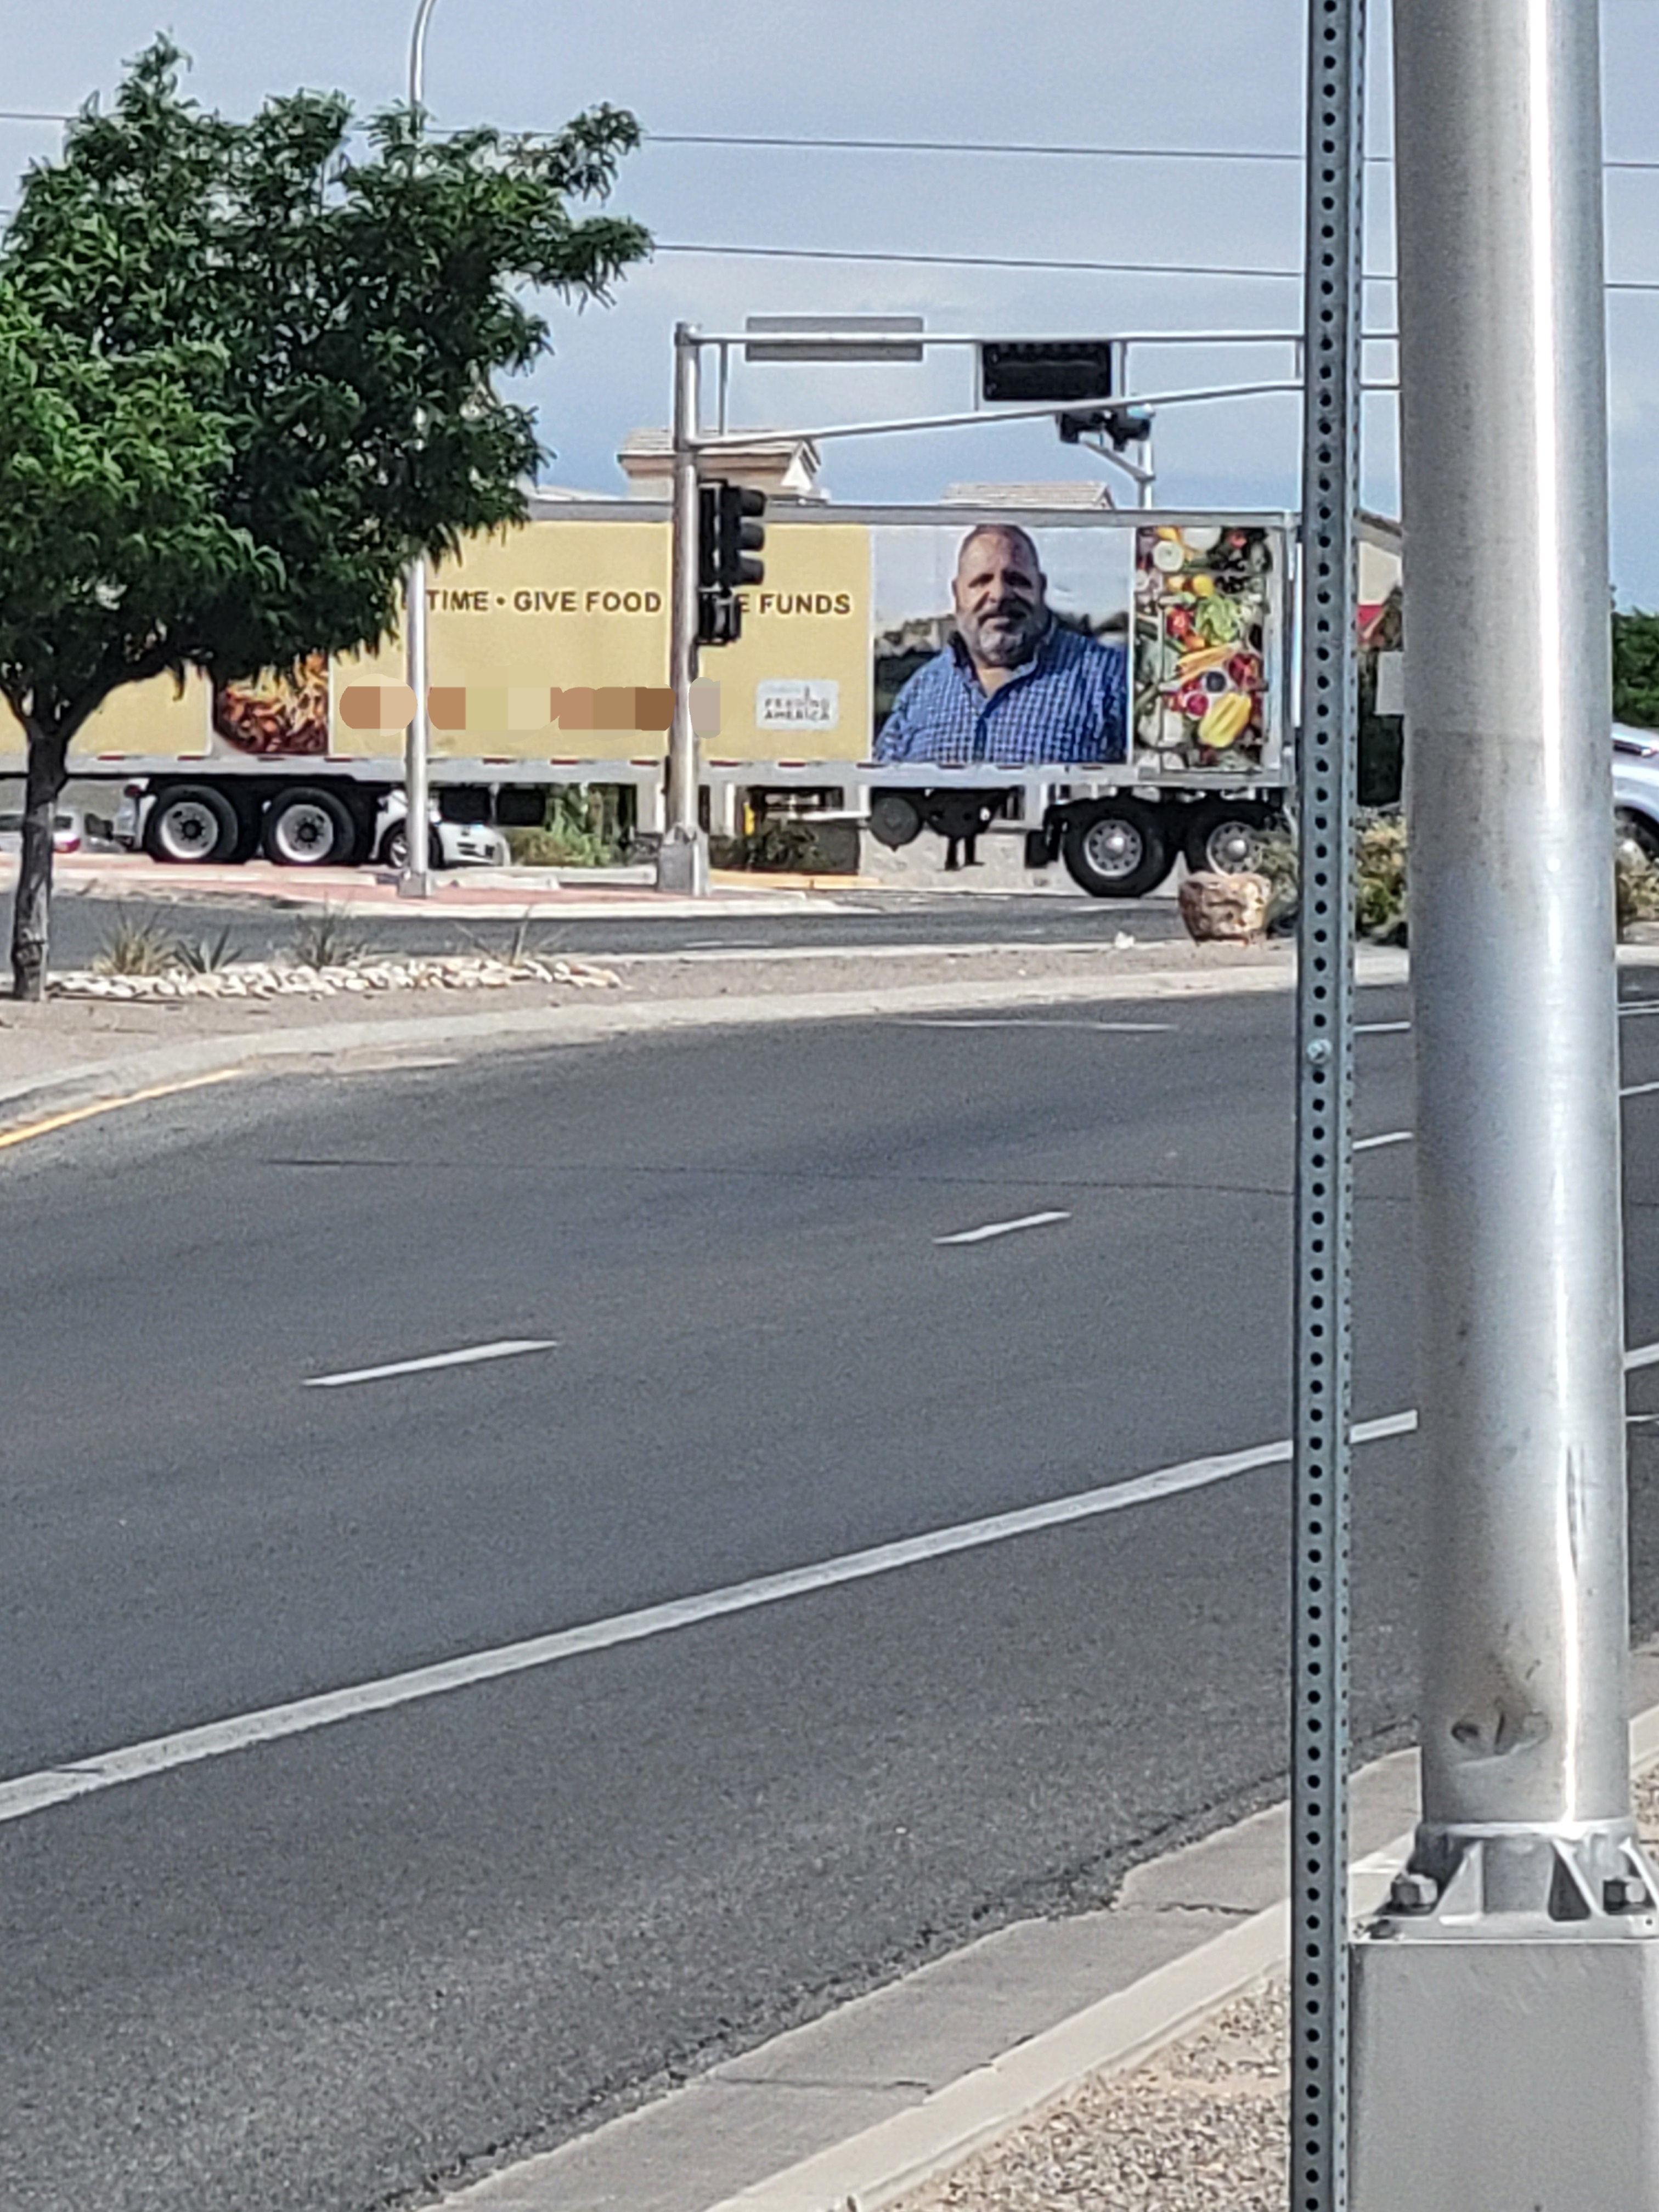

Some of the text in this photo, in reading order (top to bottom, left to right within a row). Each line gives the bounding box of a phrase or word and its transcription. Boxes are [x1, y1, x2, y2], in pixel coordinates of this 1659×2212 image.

[426, 589, 489, 611] TIME
[514, 590, 577, 612] GIVE
[585, 591, 662, 613] FOOD
[759, 594, 850, 614] FUNDS
